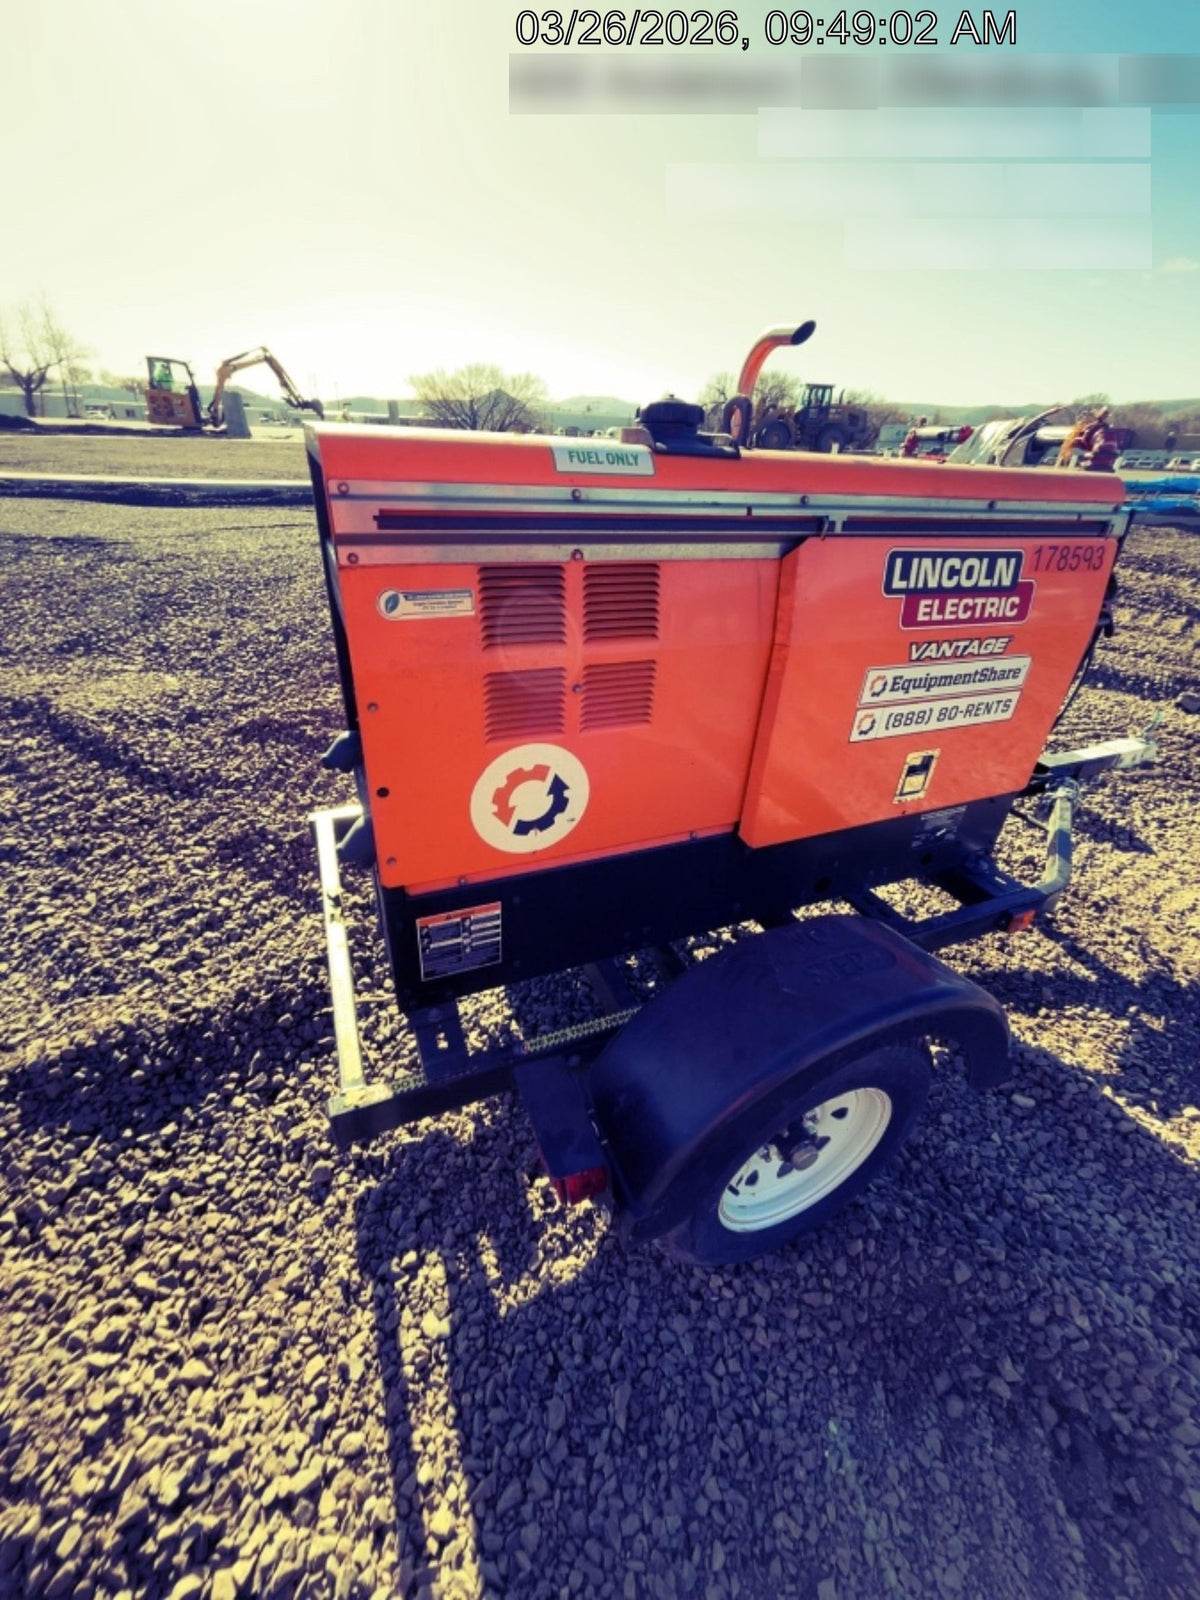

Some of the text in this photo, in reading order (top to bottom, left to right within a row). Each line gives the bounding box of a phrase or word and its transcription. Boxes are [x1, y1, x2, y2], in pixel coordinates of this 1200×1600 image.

[568, 450, 639, 467] FUEL ONLY
[1034, 546, 1104, 571] 178593
[891, 557, 1016, 590] LINCOLN
[917, 596, 1020, 622] ELECTRIC
[909, 636, 1011, 661] VANTAGE
[889, 667, 1021, 693] EquipmentShare
[884, 699, 1012, 731] (888) 80-RENTS
